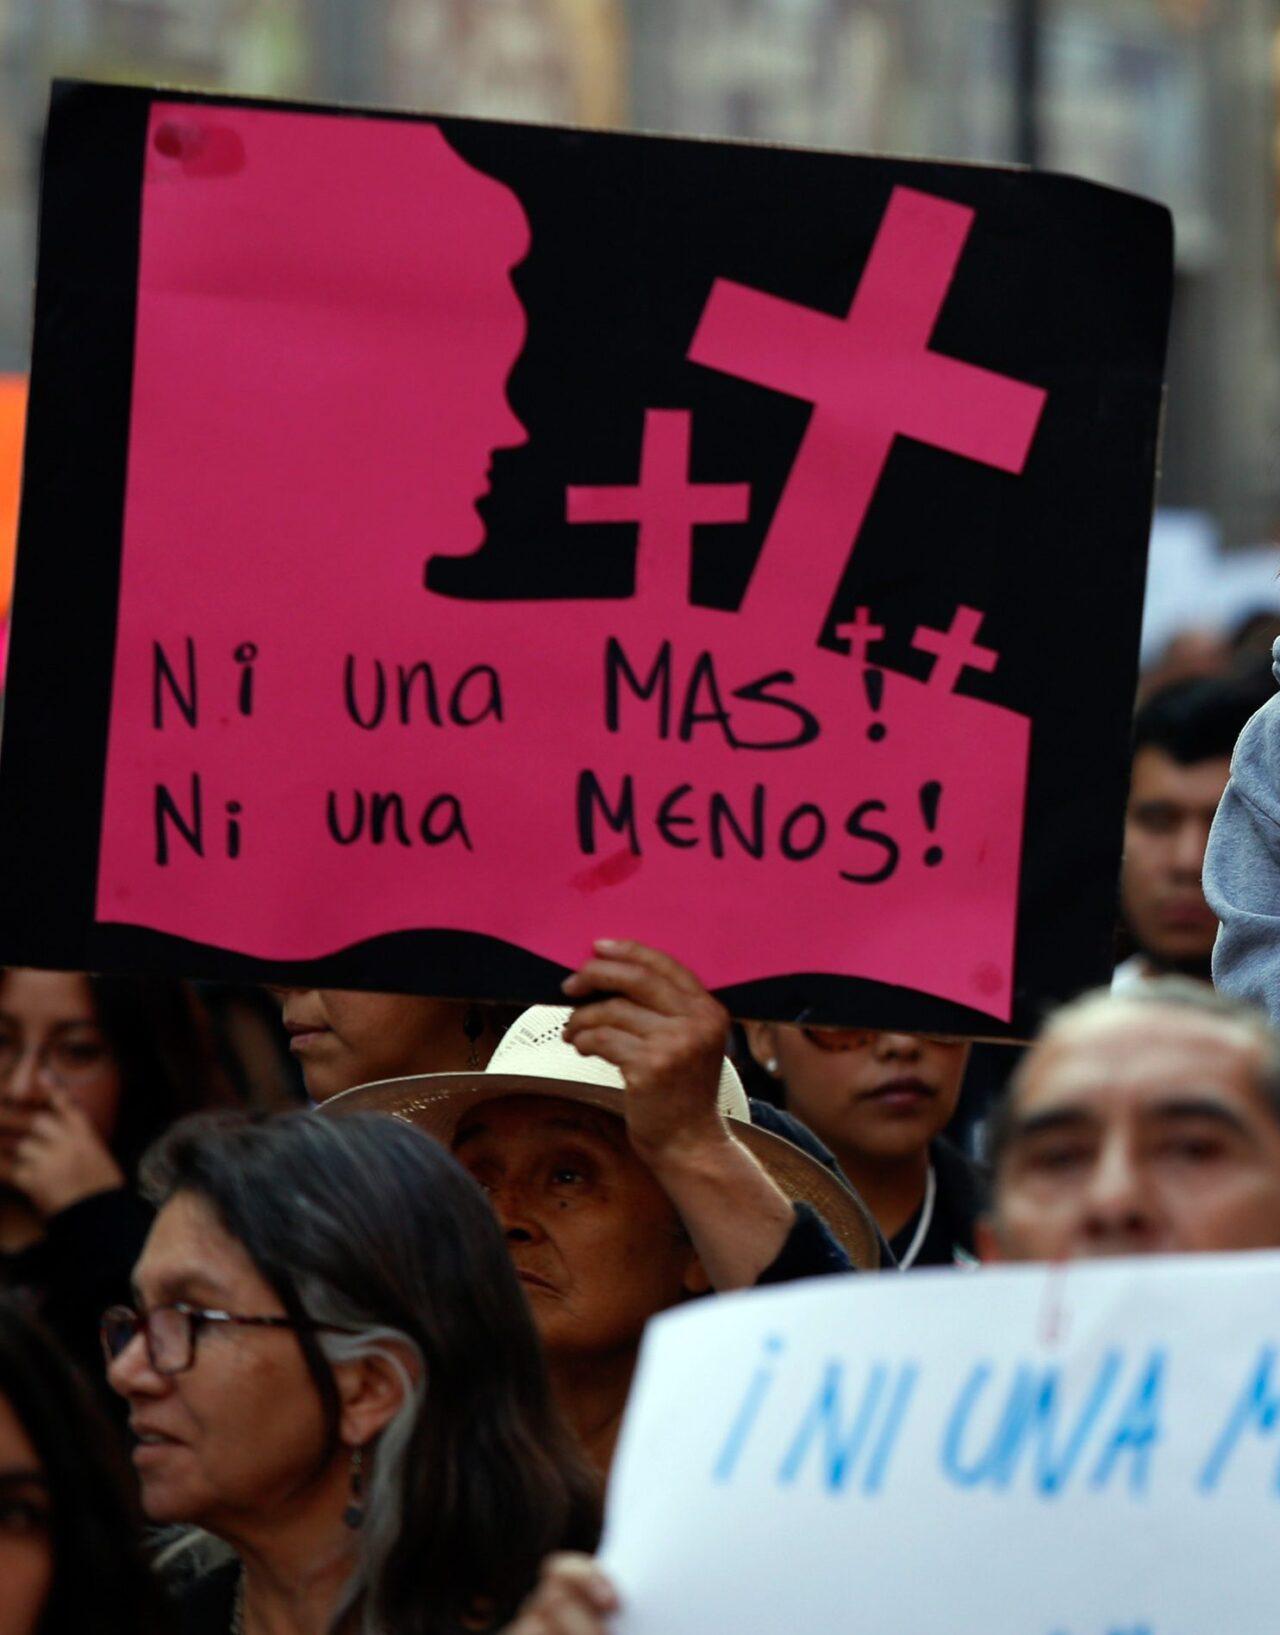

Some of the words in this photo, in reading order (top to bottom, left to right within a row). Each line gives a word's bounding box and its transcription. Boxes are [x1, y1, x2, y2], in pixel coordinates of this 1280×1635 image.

[152, 636, 259, 730] Ni
[343, 652, 504, 731] una
[153, 770, 243, 867] Ni
[325, 788, 473, 854] una
[937, 1343, 1170, 1502] UNA
